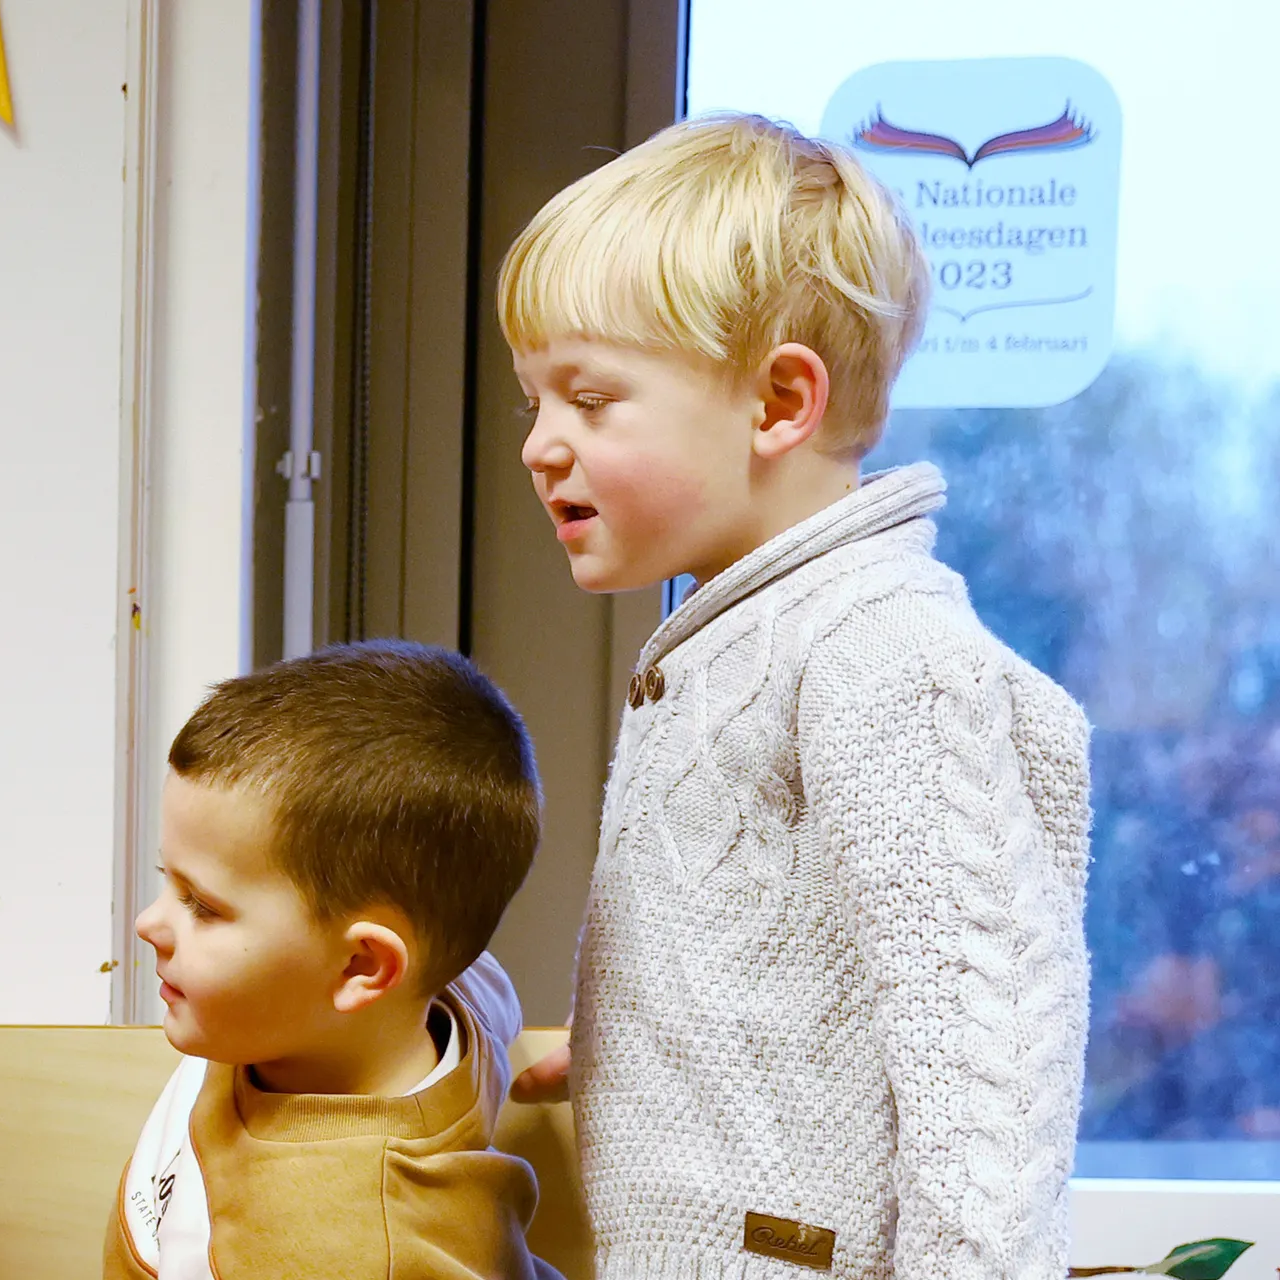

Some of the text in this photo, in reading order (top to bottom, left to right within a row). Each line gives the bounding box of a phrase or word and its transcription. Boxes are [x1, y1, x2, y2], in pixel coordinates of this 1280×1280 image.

[915, 177, 1078, 208] Nationale
[922, 220, 1089, 255] leesdagen
[931, 259, 1014, 291] 023
[1004, 334, 1089, 353] februari
